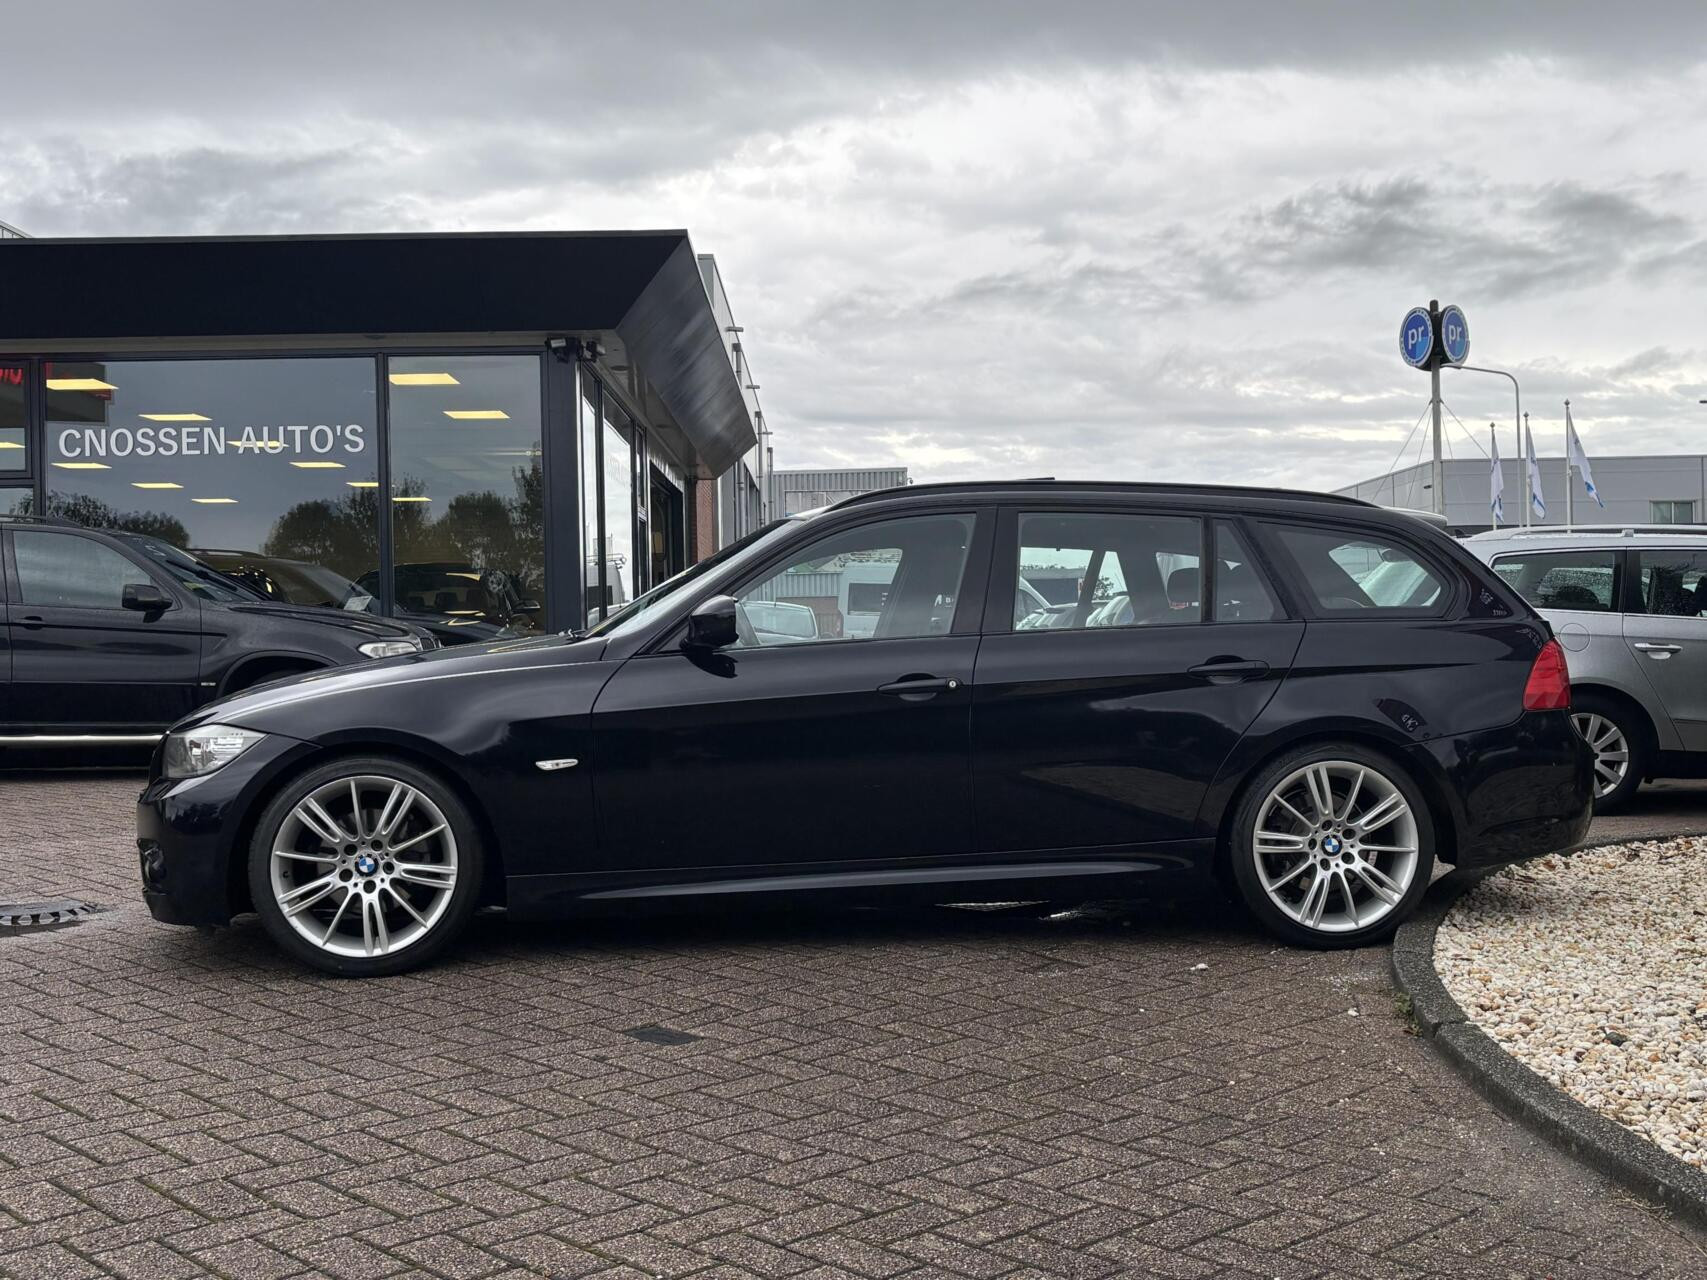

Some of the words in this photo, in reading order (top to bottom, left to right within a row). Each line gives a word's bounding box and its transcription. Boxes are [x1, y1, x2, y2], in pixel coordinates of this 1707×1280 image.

[1408, 325, 1424, 350] pr
[1448, 324, 1462, 345] pr
[58, 427, 225, 457] CNOSSEN
[238, 424, 365, 455] AUTO'S
